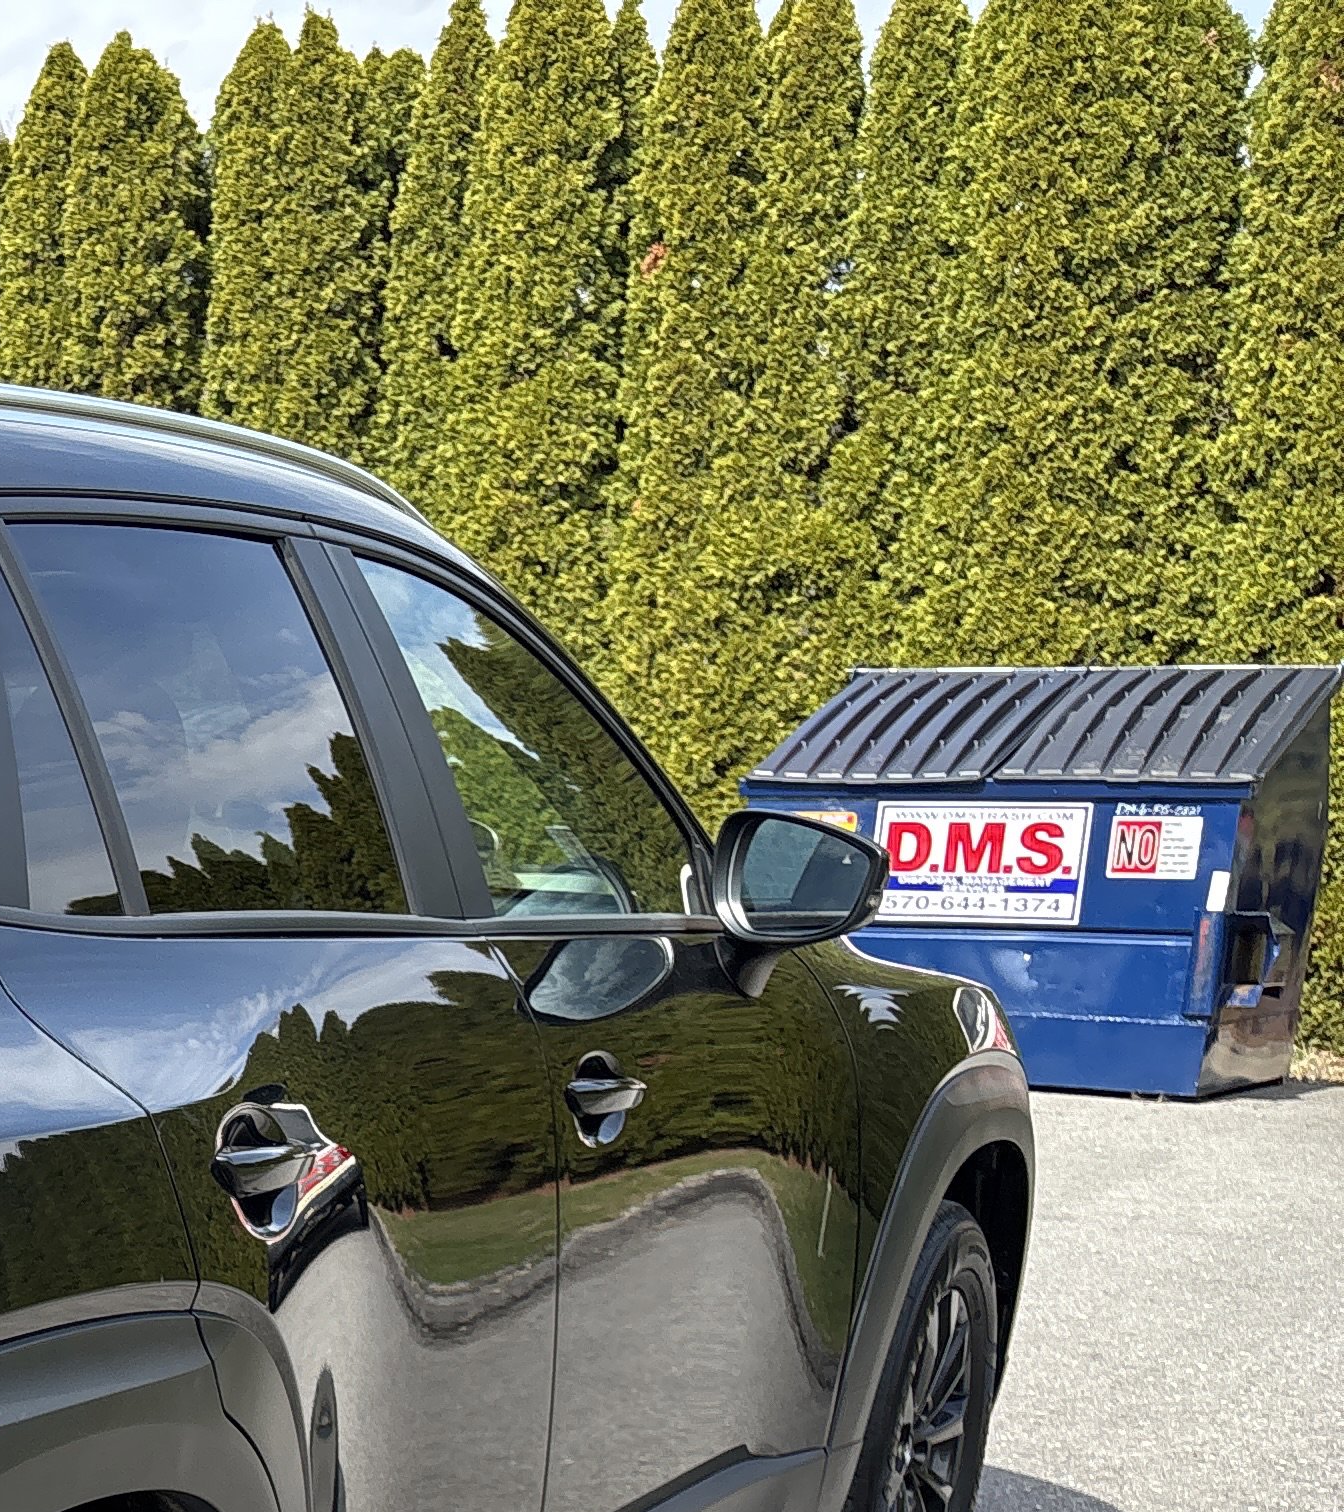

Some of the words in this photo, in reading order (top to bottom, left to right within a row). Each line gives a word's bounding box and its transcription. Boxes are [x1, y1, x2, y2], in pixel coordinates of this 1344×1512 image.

[886, 822, 1073, 874] D.M.S.
[1113, 824, 1160, 870] NO
[884, 895, 1061, 913] 570-644-1374
